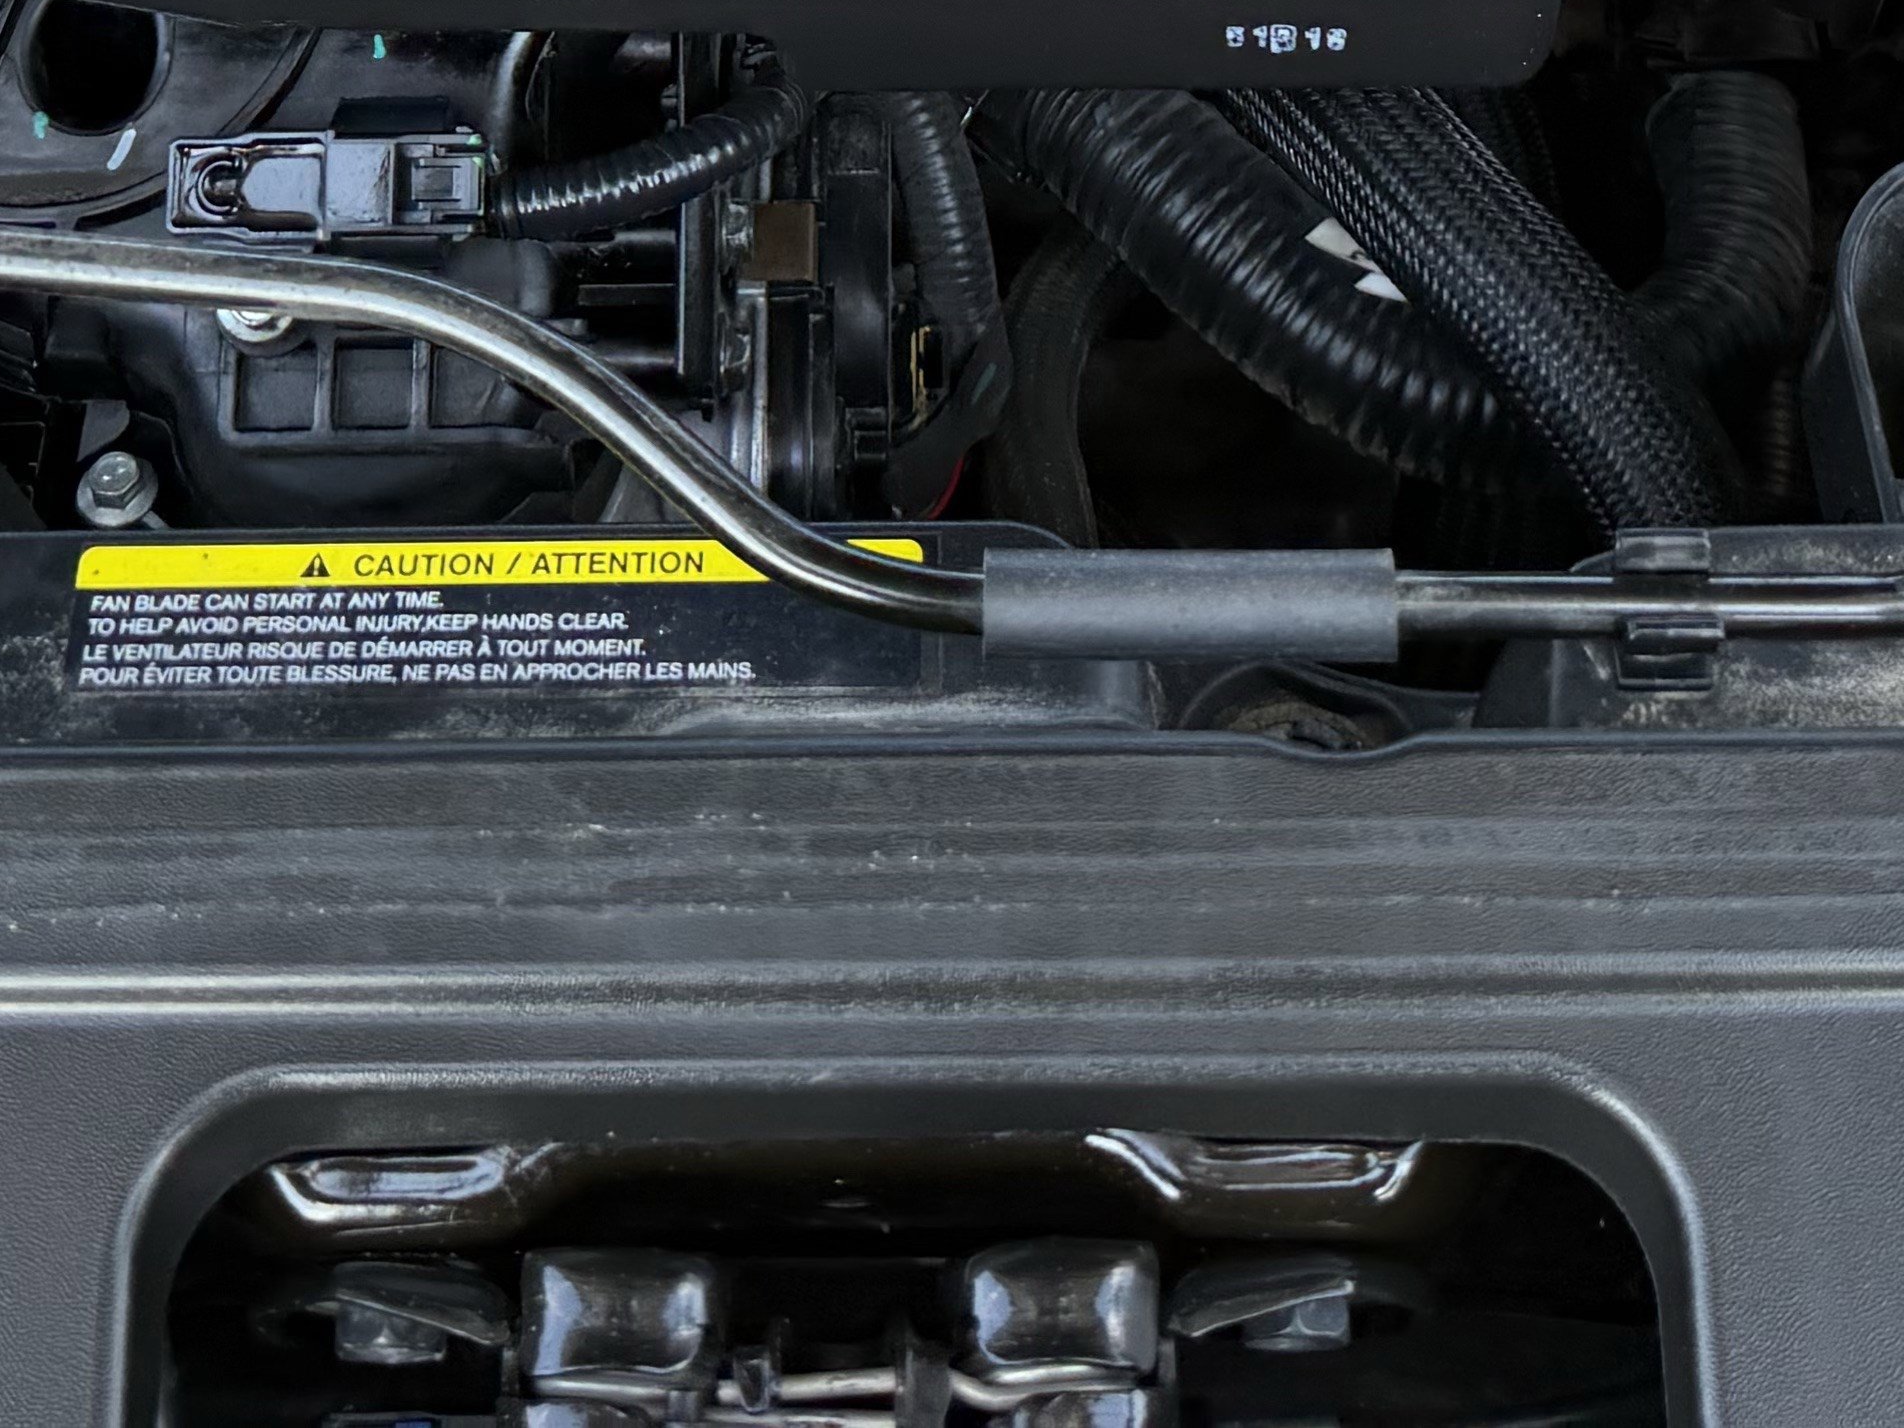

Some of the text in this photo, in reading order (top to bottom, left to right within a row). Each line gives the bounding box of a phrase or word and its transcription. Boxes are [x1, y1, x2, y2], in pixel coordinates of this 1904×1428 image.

[354, 553, 494, 577] CAUTION
[531, 551, 704, 575] ATTENTION
[91, 592, 444, 612] FAN BLADE CAN START AT ANY TIME.
[88, 618, 116, 635] TO
[119, 617, 173, 635] HELP
[175, 617, 239, 634] AVOID
[243, 616, 352, 634] PERSONAL
[482, 613, 554, 630] HANDS
[83, 635, 647, 662] LE VENTILATEUR RISQUE DE DÉMARRER À TOUT MOMENT.
[79, 661, 757, 685] POUR ÉVITER TOUTE BLESSURE, NE PAS EN APPROCHER LES MAINS.
